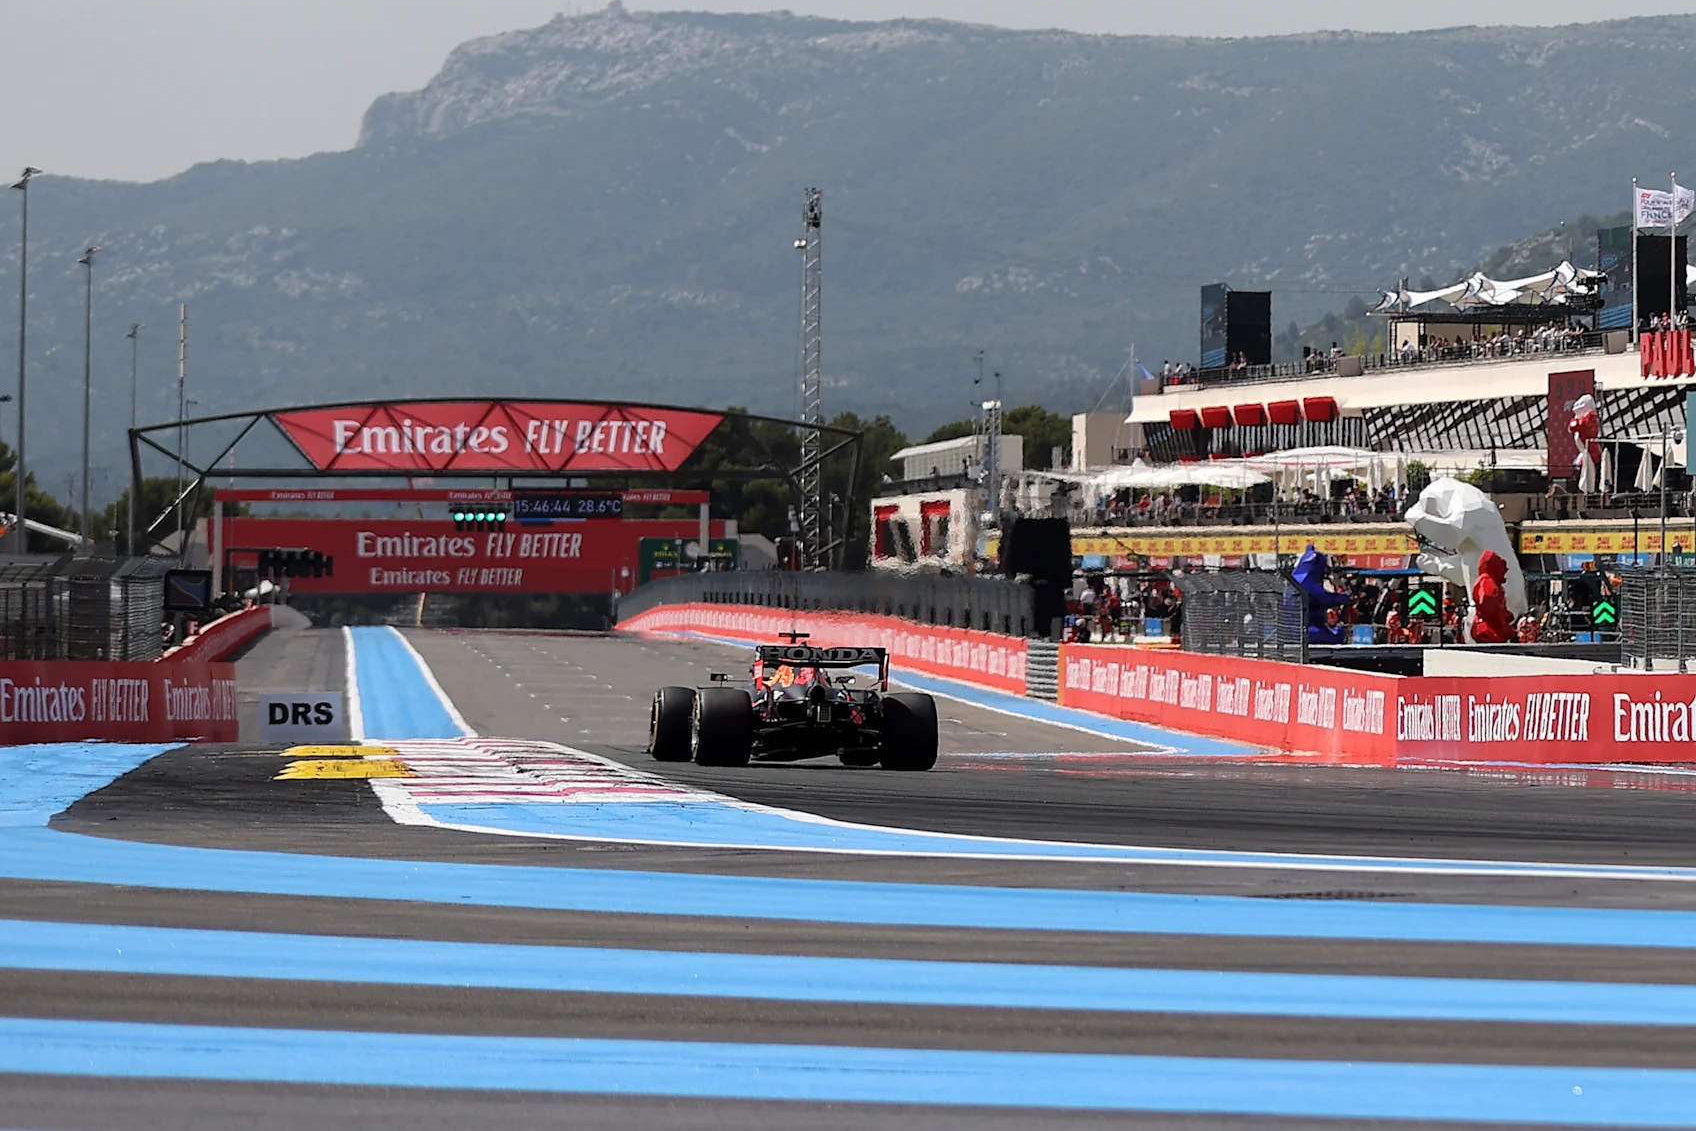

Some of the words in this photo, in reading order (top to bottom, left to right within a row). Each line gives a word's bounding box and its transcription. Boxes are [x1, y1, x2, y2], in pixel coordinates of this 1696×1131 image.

[1640, 330, 1694, 377] PAUL
[334, 419, 508, 453] Emirates
[526, 420, 568, 453] FLY
[575, 419, 666, 453] BETTER
[512, 500, 571, 513] 15:46:44
[358, 532, 475, 557] Emirates
[486, 533, 516, 557] FLY
[519, 533, 582, 557] BETTER
[371, 568, 450, 584] Emirates
[457, 568, 478, 585] FLY
[480, 568, 523, 585] BETTER
[762, 647, 880, 661] HONDA
[0, 677, 86, 722] Emirates
[92, 678, 108, 721] FLY
[109, 678, 149, 721] BETTER
[269, 702, 333, 725] DRS
[1468, 693, 1521, 742] Emirates
[1541, 692, 1590, 741] BETTER
